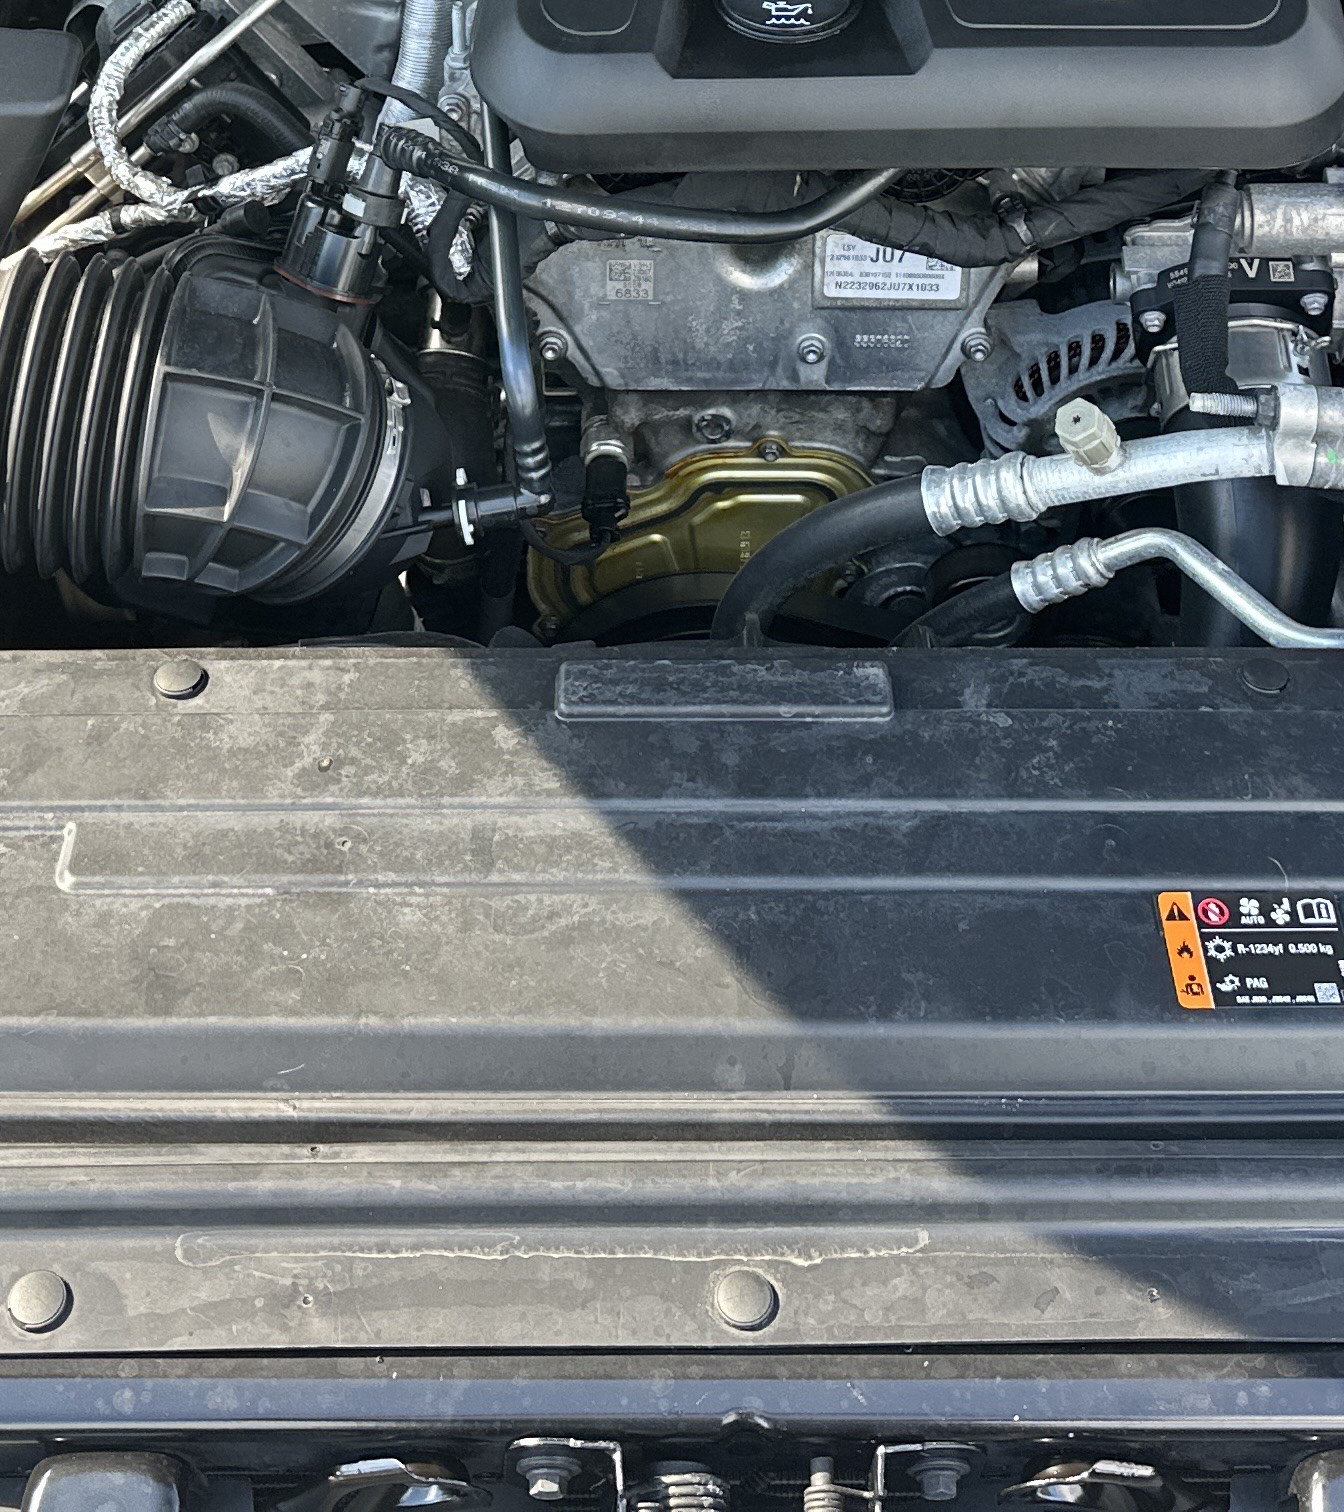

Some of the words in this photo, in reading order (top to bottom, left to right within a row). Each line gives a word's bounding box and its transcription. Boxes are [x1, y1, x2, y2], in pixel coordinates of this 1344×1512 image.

[1239, 258, 1260, 278] V
[616, 288, 649, 299] 6833
[1240, 915, 1265, 925] AUTO
[1236, 943, 1284, 956] R-1234yf
[1287, 943, 1318, 954] 0.500
[1318, 942, 1334, 956] kg
[1245, 977, 1269, 989] PAG
